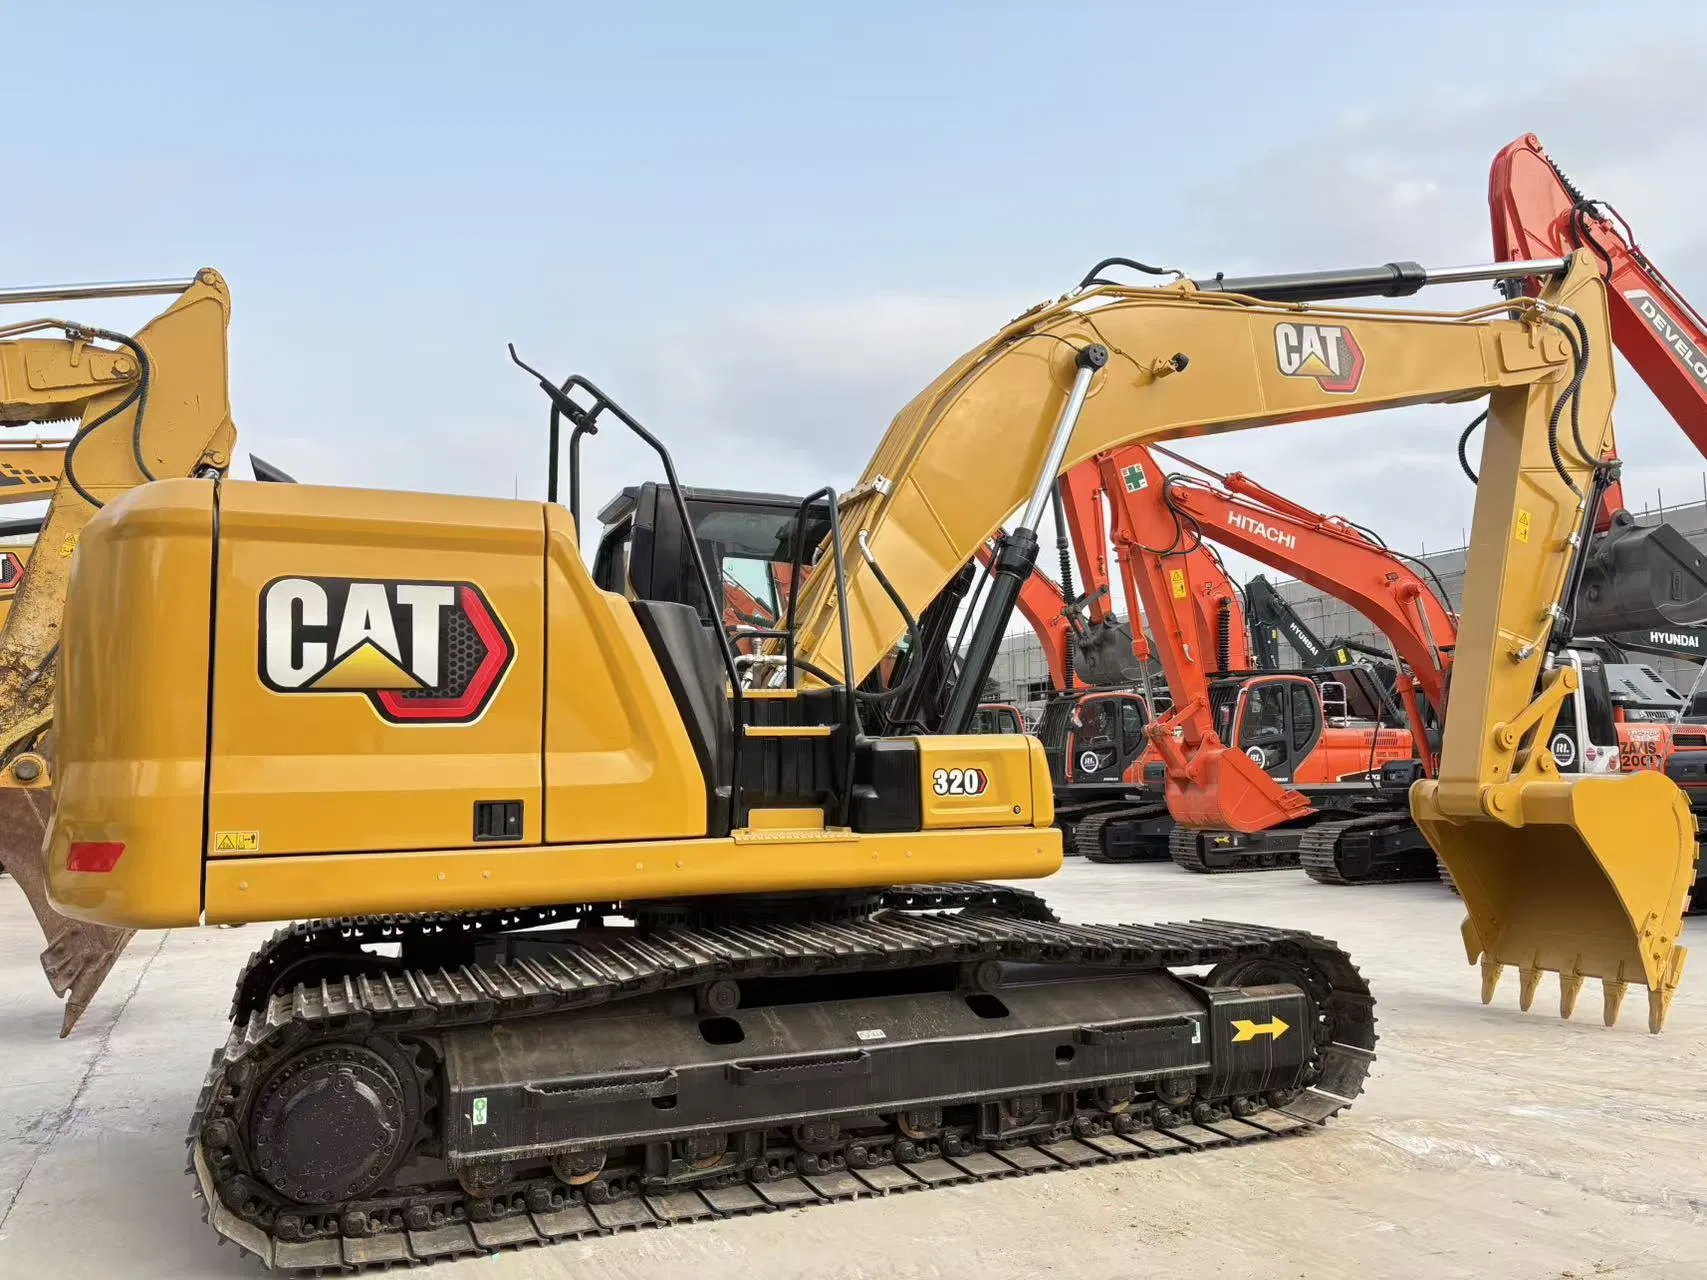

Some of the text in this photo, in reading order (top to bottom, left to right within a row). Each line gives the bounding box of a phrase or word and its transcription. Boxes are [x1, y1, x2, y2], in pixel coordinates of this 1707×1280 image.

[1276, 323, 1341, 376] CAT
[1640, 300, 1707, 384] DEVELO
[1228, 511, 1296, 549] HITACHI
[266, 578, 455, 688] CAT
[1290, 622, 1319, 657] HYUNDAI
[1650, 631, 1699, 647] HYUNDAI
[933, 768, 979, 795] 320
